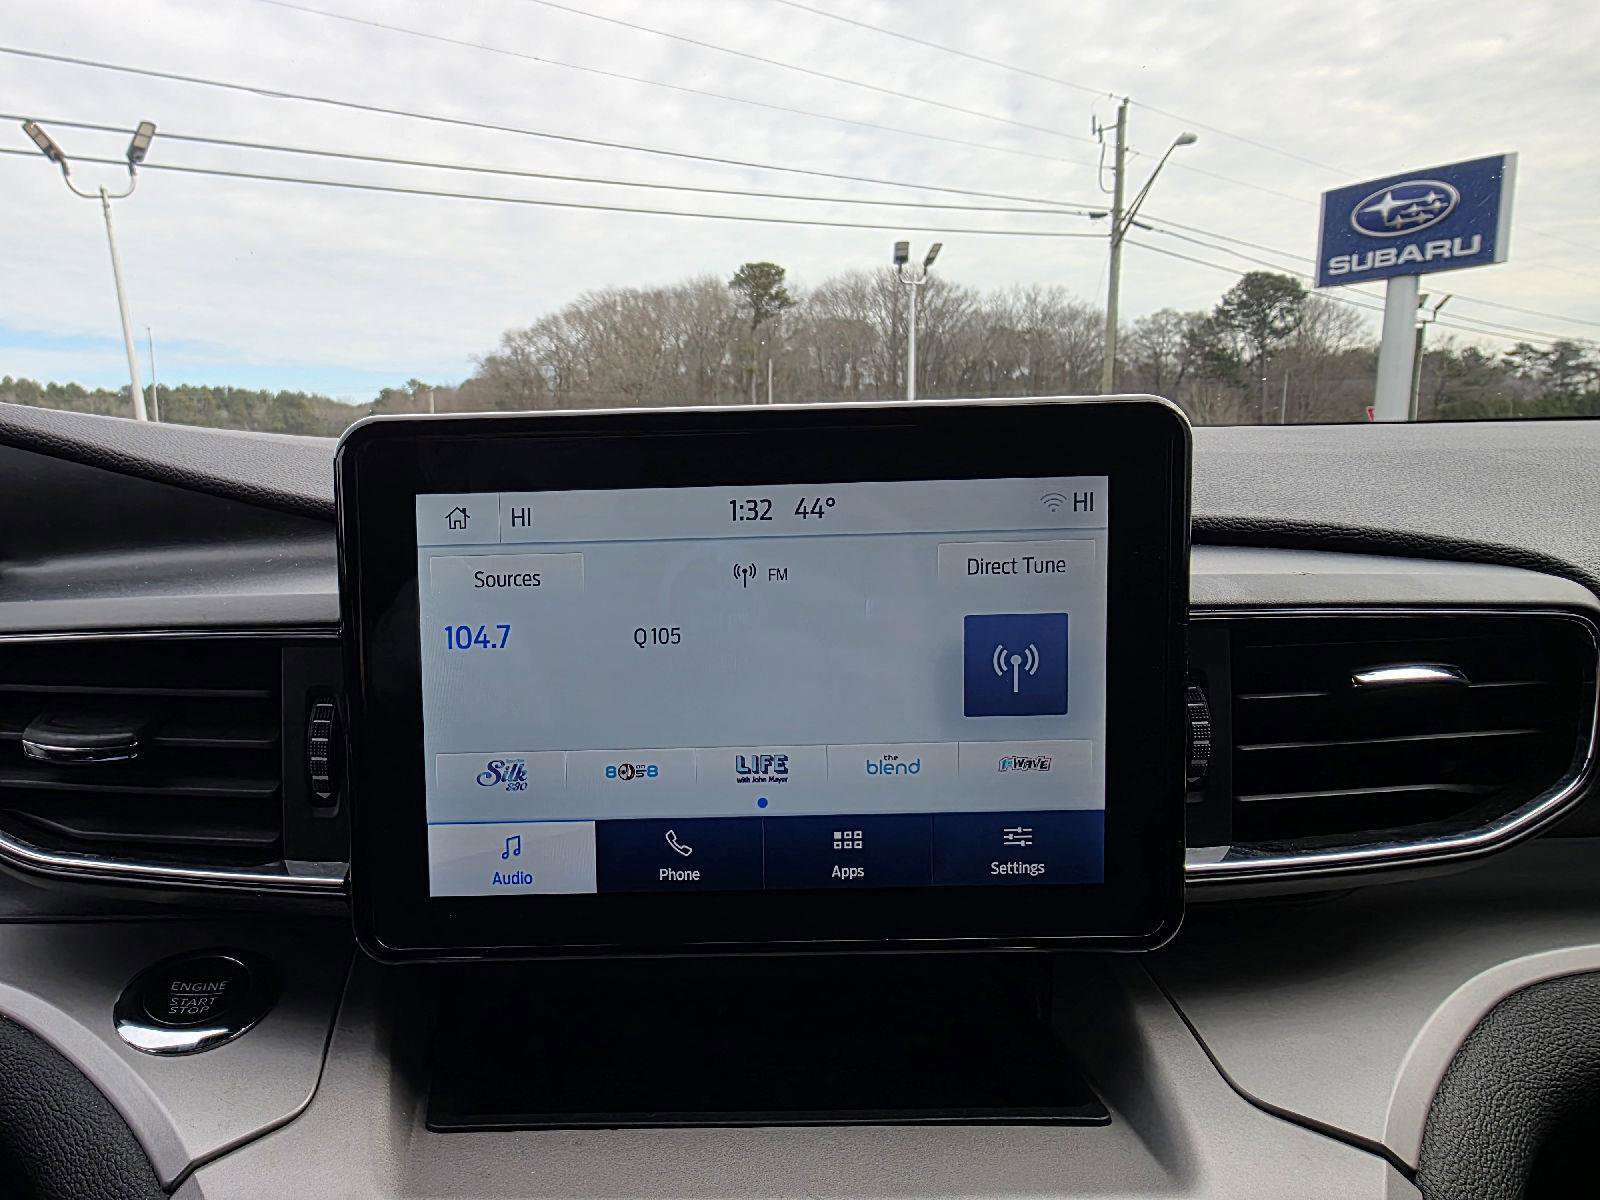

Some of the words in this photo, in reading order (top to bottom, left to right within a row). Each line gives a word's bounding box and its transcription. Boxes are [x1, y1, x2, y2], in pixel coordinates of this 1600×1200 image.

[1327, 233, 1482, 275] SUBARU
[729, 499, 773, 521] 1:32
[794, 497, 836, 519] 44°
[1073, 491, 1094, 512] HI
[511, 507, 531, 527] HI
[768, 567, 788, 581] FM
[967, 557, 1018, 575] Direct
[1022, 556, 1066, 574] Tune
[474, 570, 541, 588] Sources
[444, 624, 511, 649] 104.7
[736, 754, 788, 774] LIFE
[866, 758, 920, 775] blend
[476, 759, 528, 787] Silk
[752, 775, 767, 783] John
[492, 870, 533, 885] Audio
[659, 868, 700, 881] Phone
[831, 865, 865, 880] Apps
[991, 861, 1046, 877] Settings
[171, 980, 230, 992] ENGINE
[168, 1005, 210, 1014] STOP
[169, 996, 217, 1006] START
